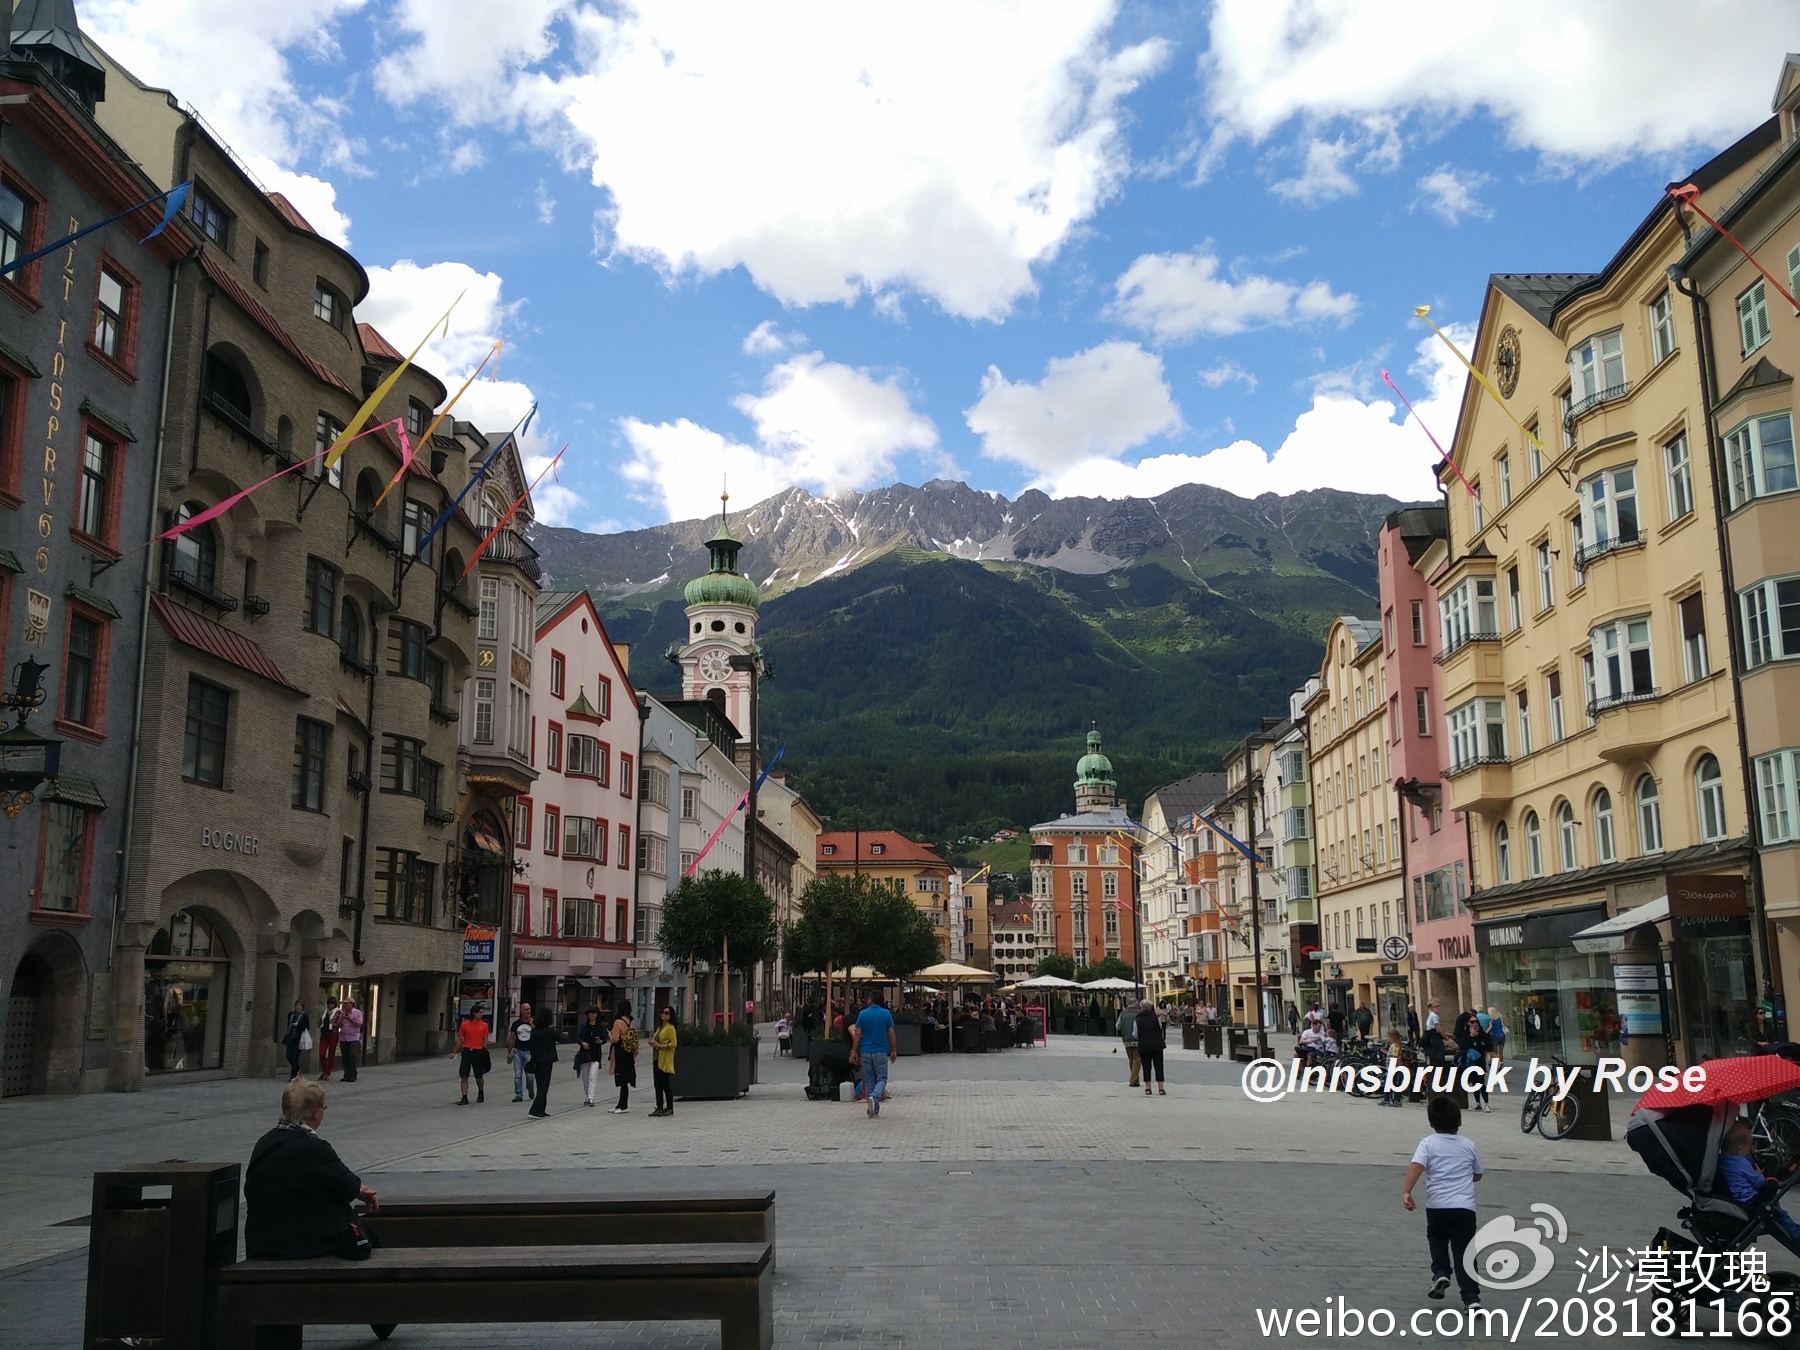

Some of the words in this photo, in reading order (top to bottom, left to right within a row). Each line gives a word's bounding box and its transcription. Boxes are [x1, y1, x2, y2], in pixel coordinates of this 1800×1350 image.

[202, 827, 260, 856] BOGNER
[1678, 889, 1737, 901] Weigand
[1488, 925, 1523, 946] HUMANIC
[464, 941, 490, 954] SEGAAR
[1437, 934, 1472, 960] TYROLIA
